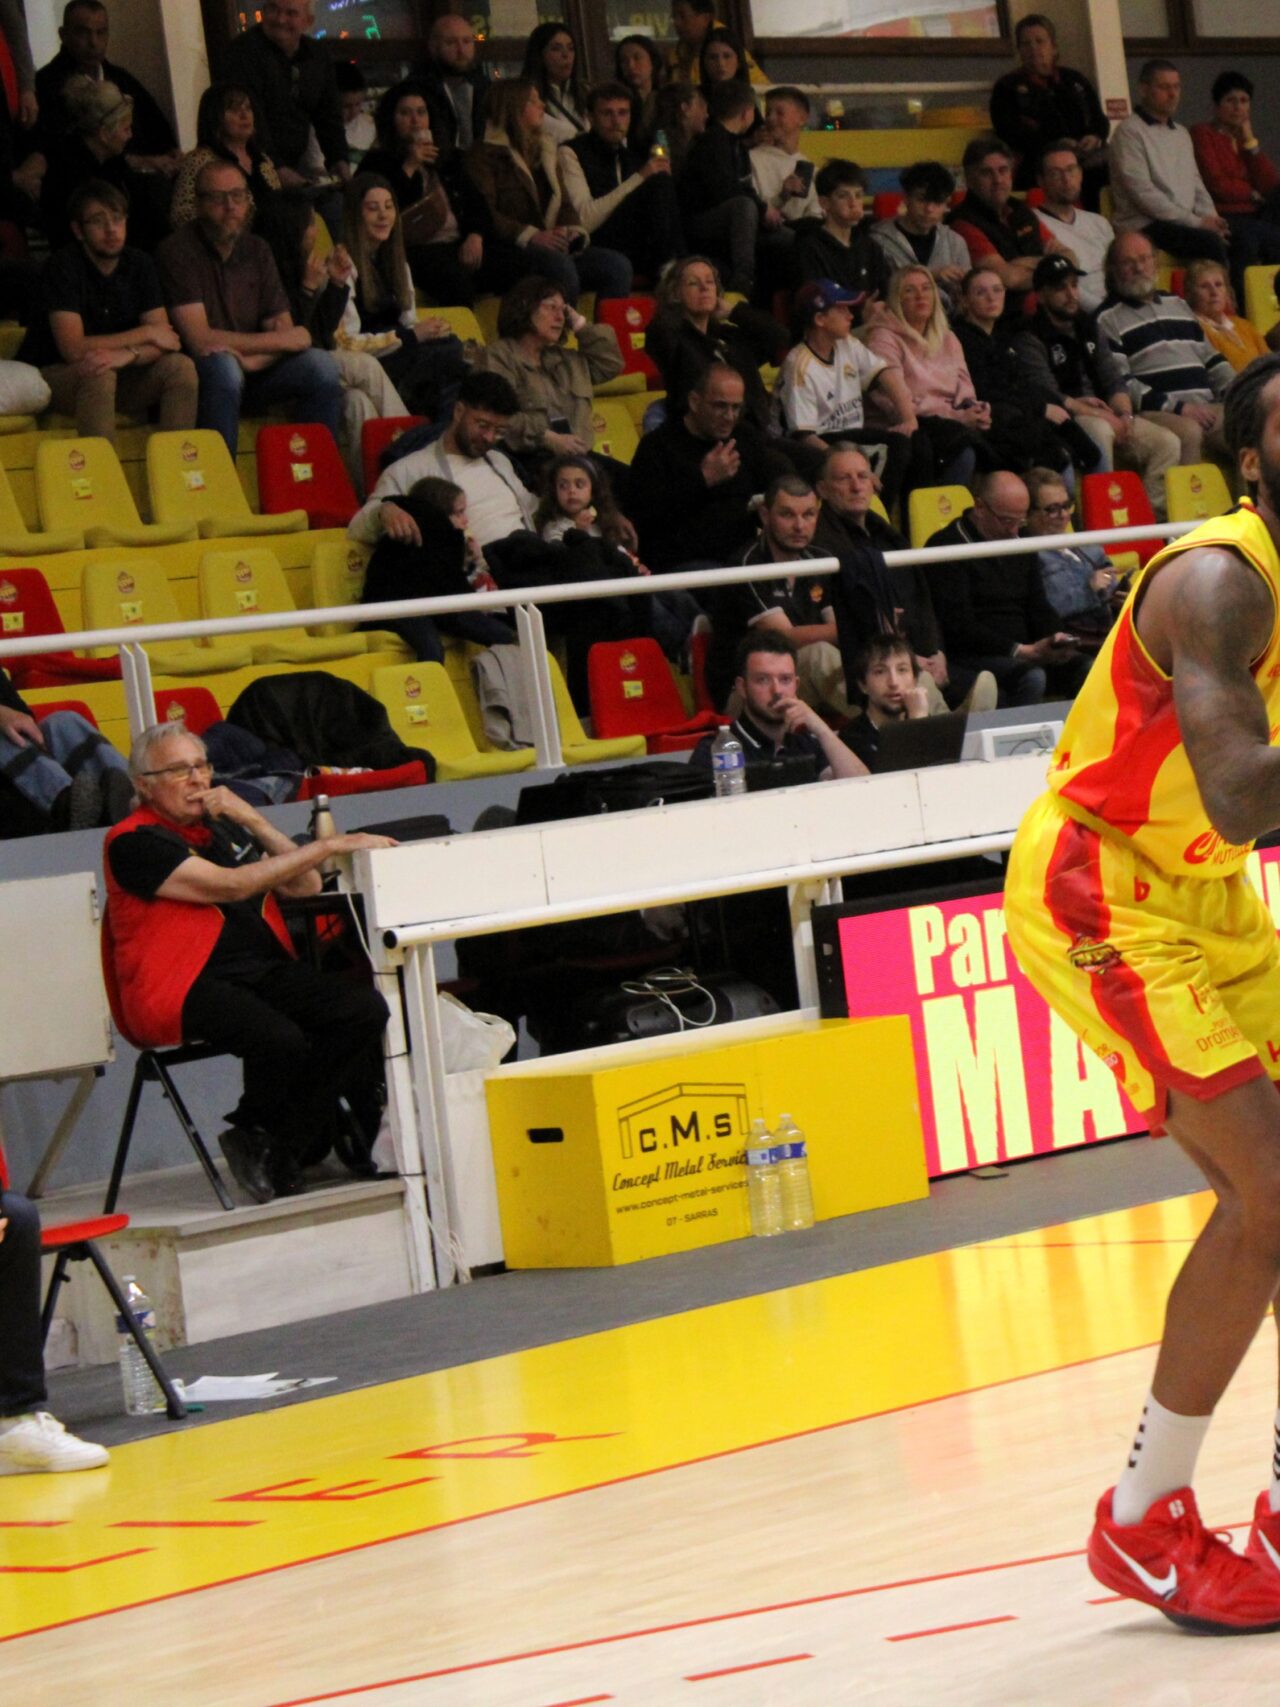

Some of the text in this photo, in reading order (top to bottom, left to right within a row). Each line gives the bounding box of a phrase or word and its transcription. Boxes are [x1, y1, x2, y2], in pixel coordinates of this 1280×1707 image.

[612, 1150, 748, 1191] Concept Metal Servic
